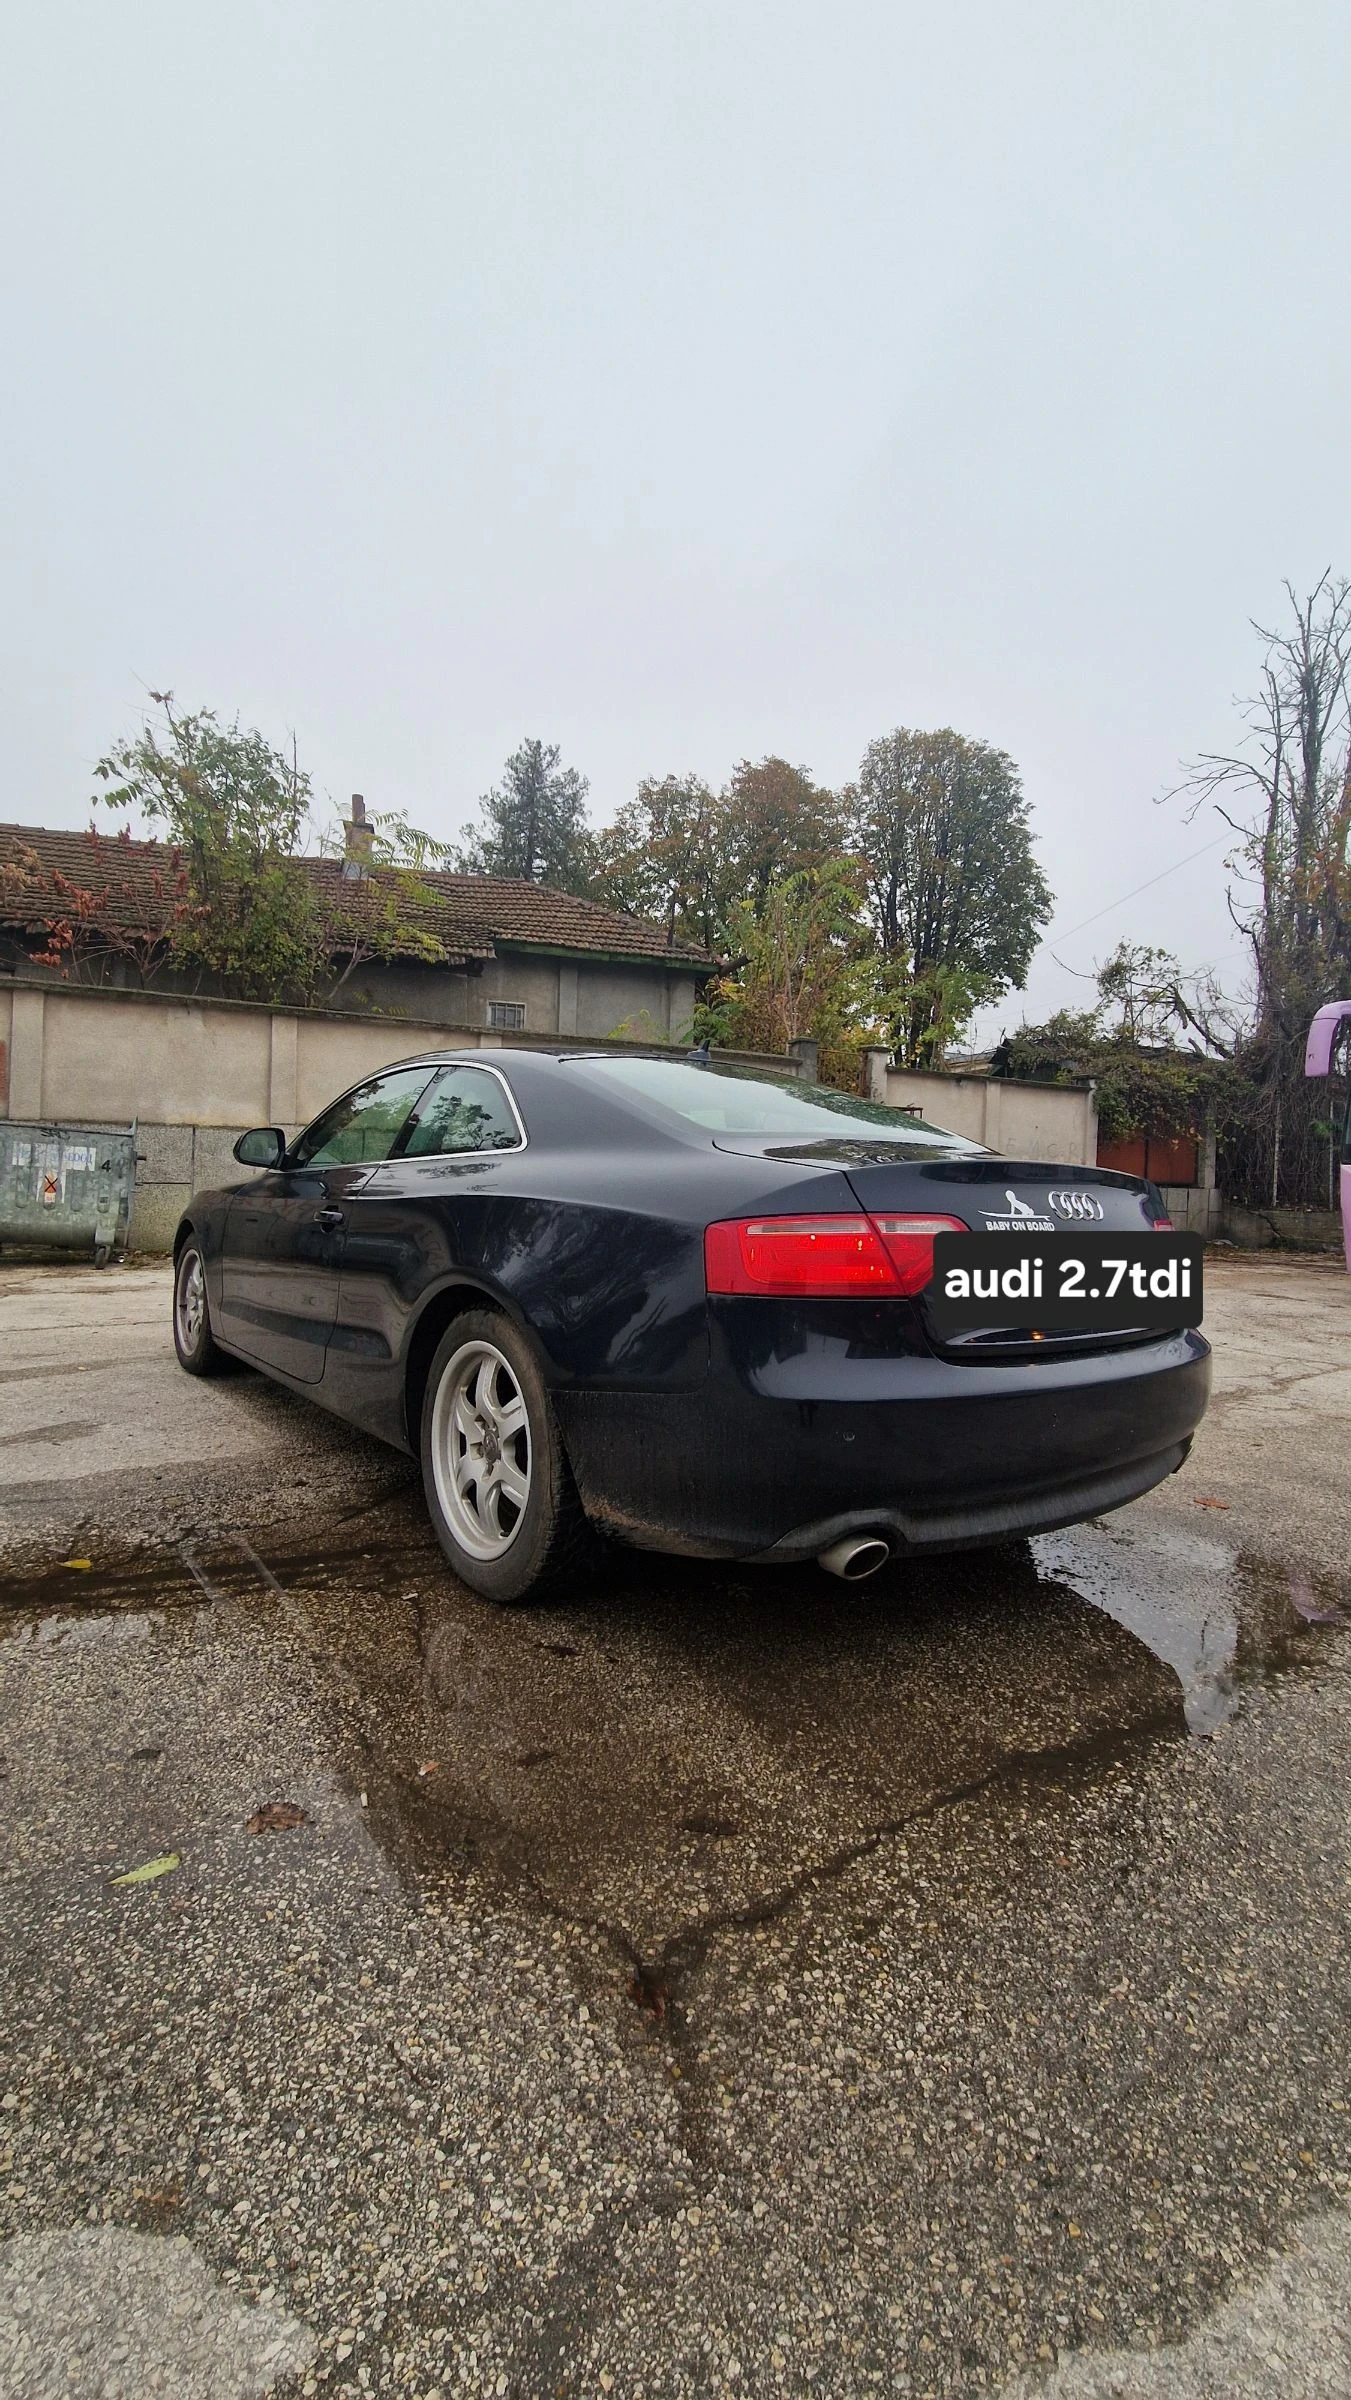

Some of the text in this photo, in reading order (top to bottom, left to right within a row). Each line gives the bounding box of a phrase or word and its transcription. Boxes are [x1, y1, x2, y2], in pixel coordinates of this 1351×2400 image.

[101, 1159, 111, 1172] 4
[986, 1221, 1055, 1232] BABY ON BOARD
